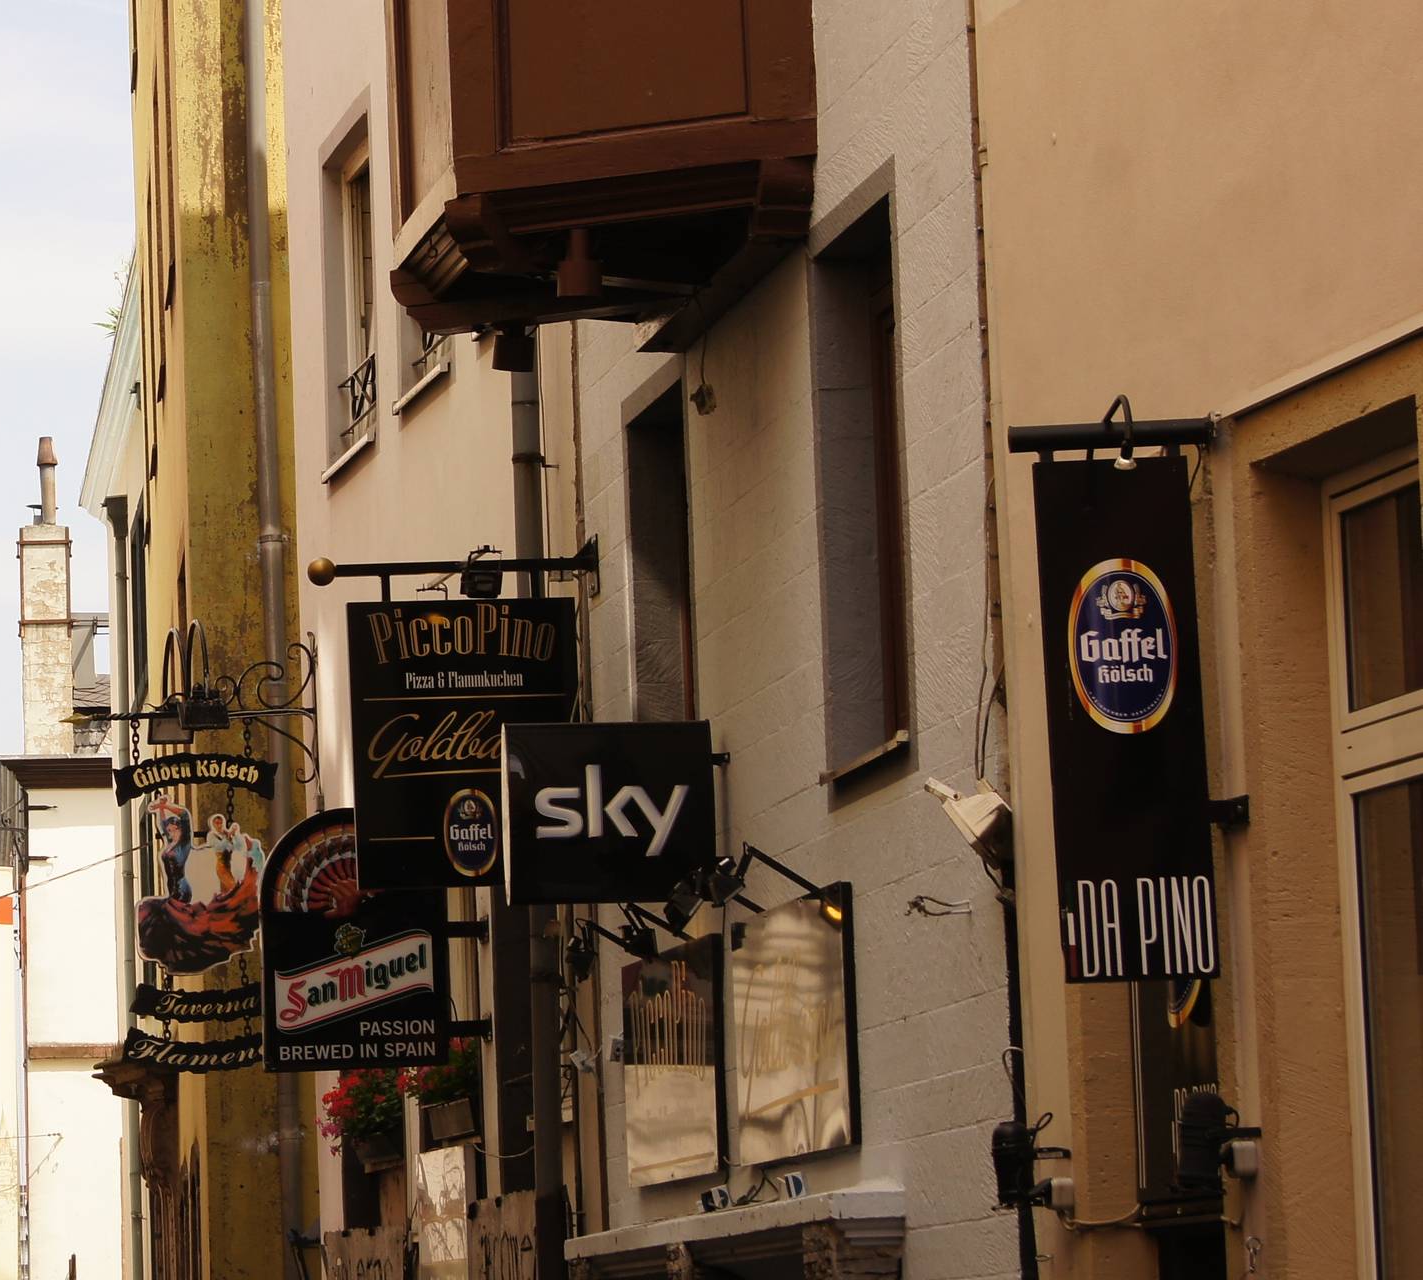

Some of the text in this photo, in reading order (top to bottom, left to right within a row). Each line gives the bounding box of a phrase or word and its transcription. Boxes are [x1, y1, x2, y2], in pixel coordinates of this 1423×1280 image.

[368, 603, 556, 665] PiccoPino
[1079, 628, 1168, 666] Gaffel
[405, 670, 524, 690] Pizza & Flammkuchen
[1098, 664, 1154, 685] Kölsch
[367, 710, 504, 779] Goldba
[132, 759, 259, 788] Gilden Kölsch
[534, 764, 689, 857] sky
[449, 823, 494, 844] Gaffel
[1077, 875, 1215, 979] DA PINO
[155, 993, 258, 1017] Taverna
[359, 1019, 436, 1037] PASSION
[279, 1041, 436, 1062] BREWED IN SPAIN
